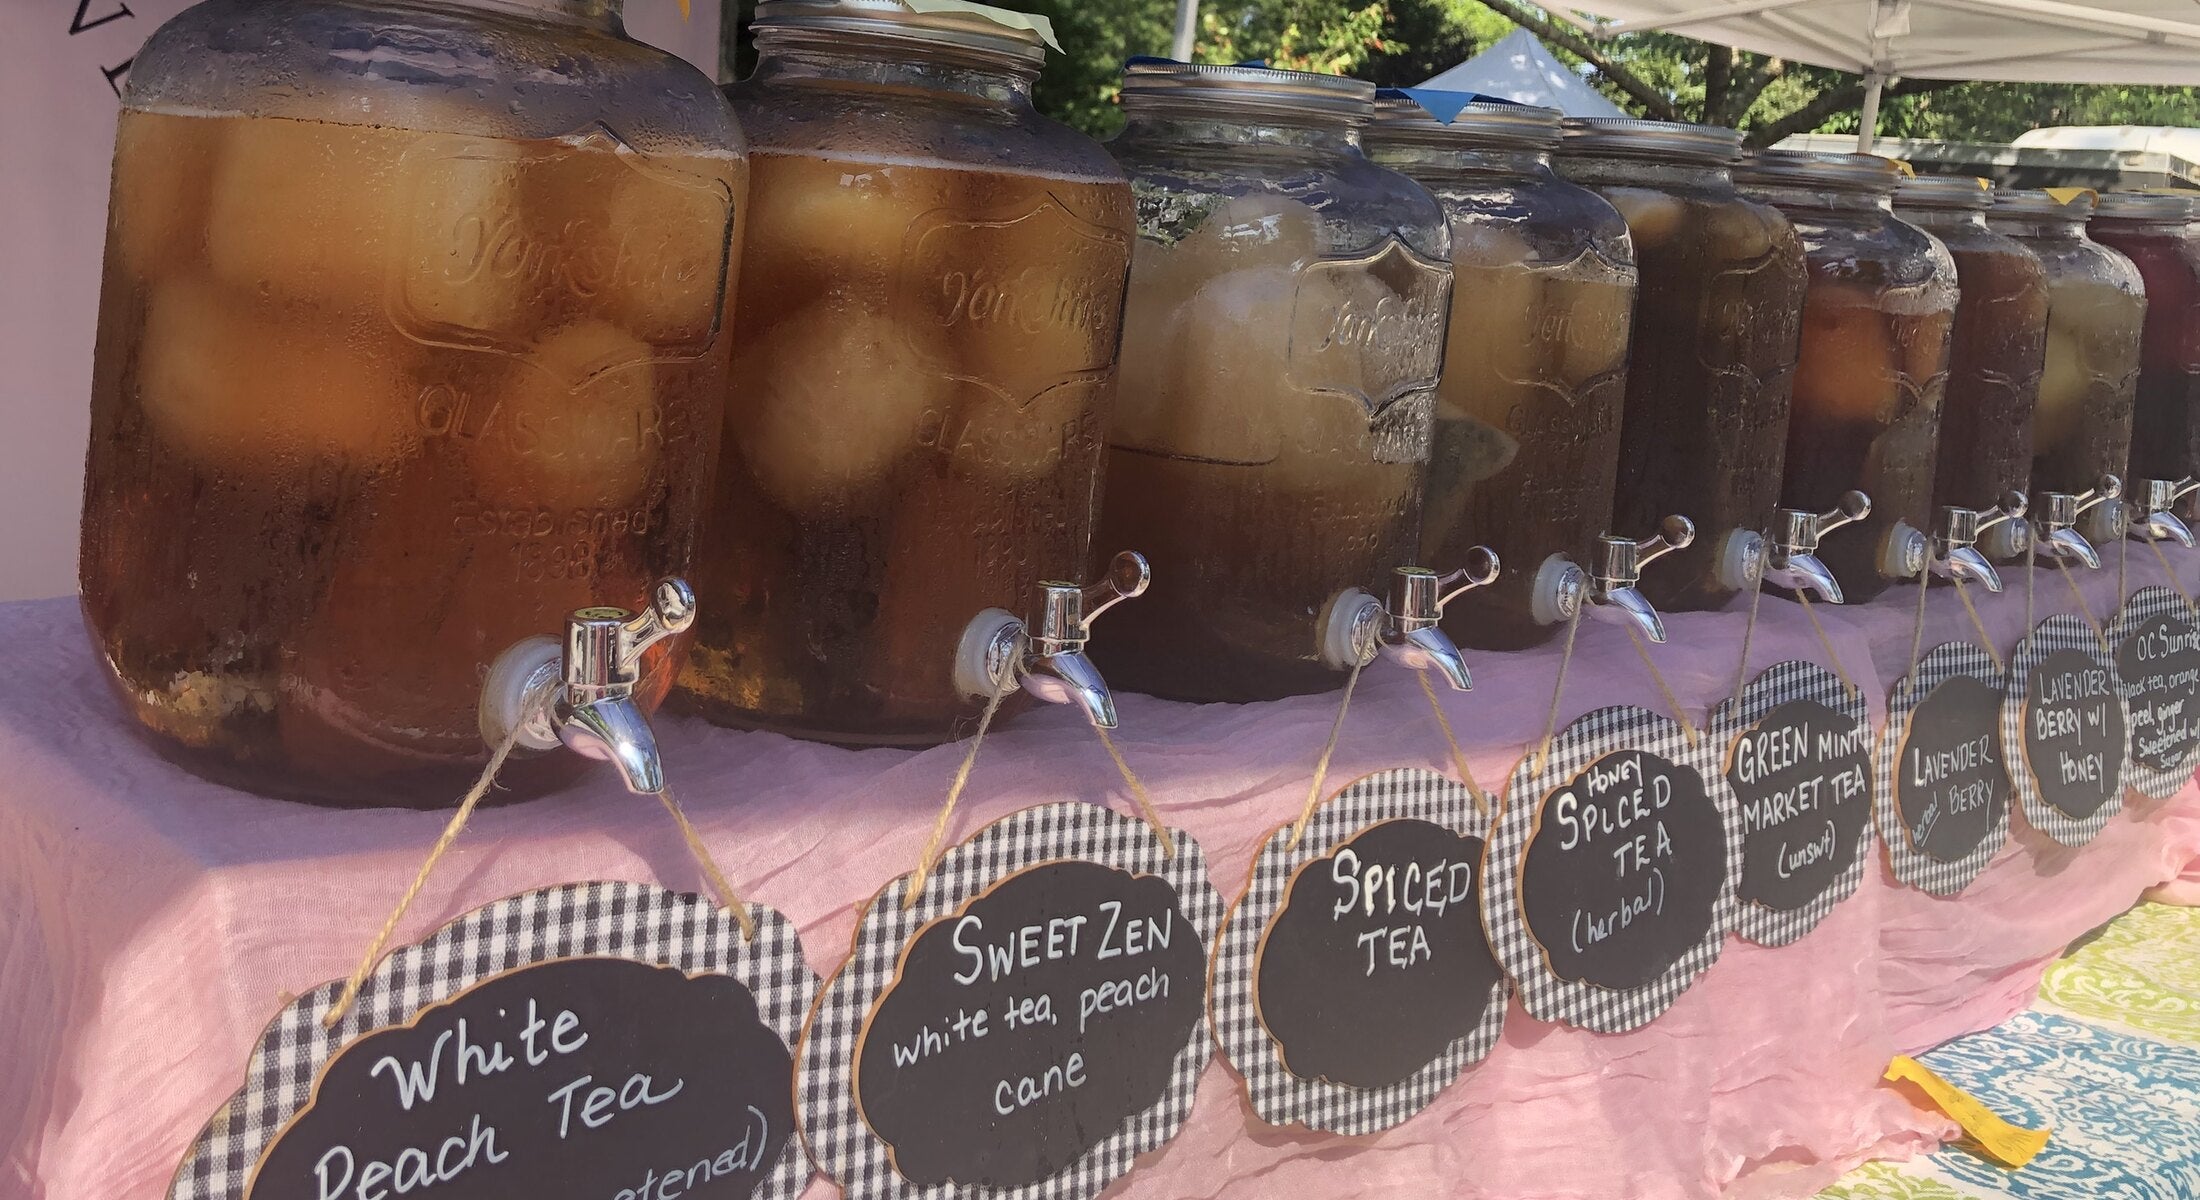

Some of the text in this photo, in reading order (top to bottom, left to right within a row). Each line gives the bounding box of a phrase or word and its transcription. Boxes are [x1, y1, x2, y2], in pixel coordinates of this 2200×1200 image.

[2137, 631, 2157, 661] OC
[2039, 669, 2110, 705] LAVENDER
[2148, 674, 2168, 693] tea,
[2169, 668, 2200, 695] orange
[2036, 707, 2082, 746] BERRY
[2131, 698, 2185, 735] peel, ginger
[1588, 753, 1644, 797] HONEY
[1737, 721, 1862, 784] GREEN MINT
[1914, 734, 1994, 788] LAVENDER
[2060, 751, 2104, 794] HONEY
[1556, 775, 1672, 850] SPICED
[1743, 763, 1866, 835] MARKET TEA
[1949, 778, 1994, 831] BERRY
[1613, 821, 1673, 878] TEA
[1332, 848, 1471, 921] SPICED
[1572, 868, 1666, 953] (herbal)
[953, 900, 1172, 986] SWEET ZEN
[1357, 925, 1432, 977] TEA
[893, 1008, 989, 1069] white
[1080, 966, 1170, 1034] peach
[371, 998, 589, 1110] White
[548, 1073, 684, 1139] Tea
[994, 1052, 1087, 1115] cane
